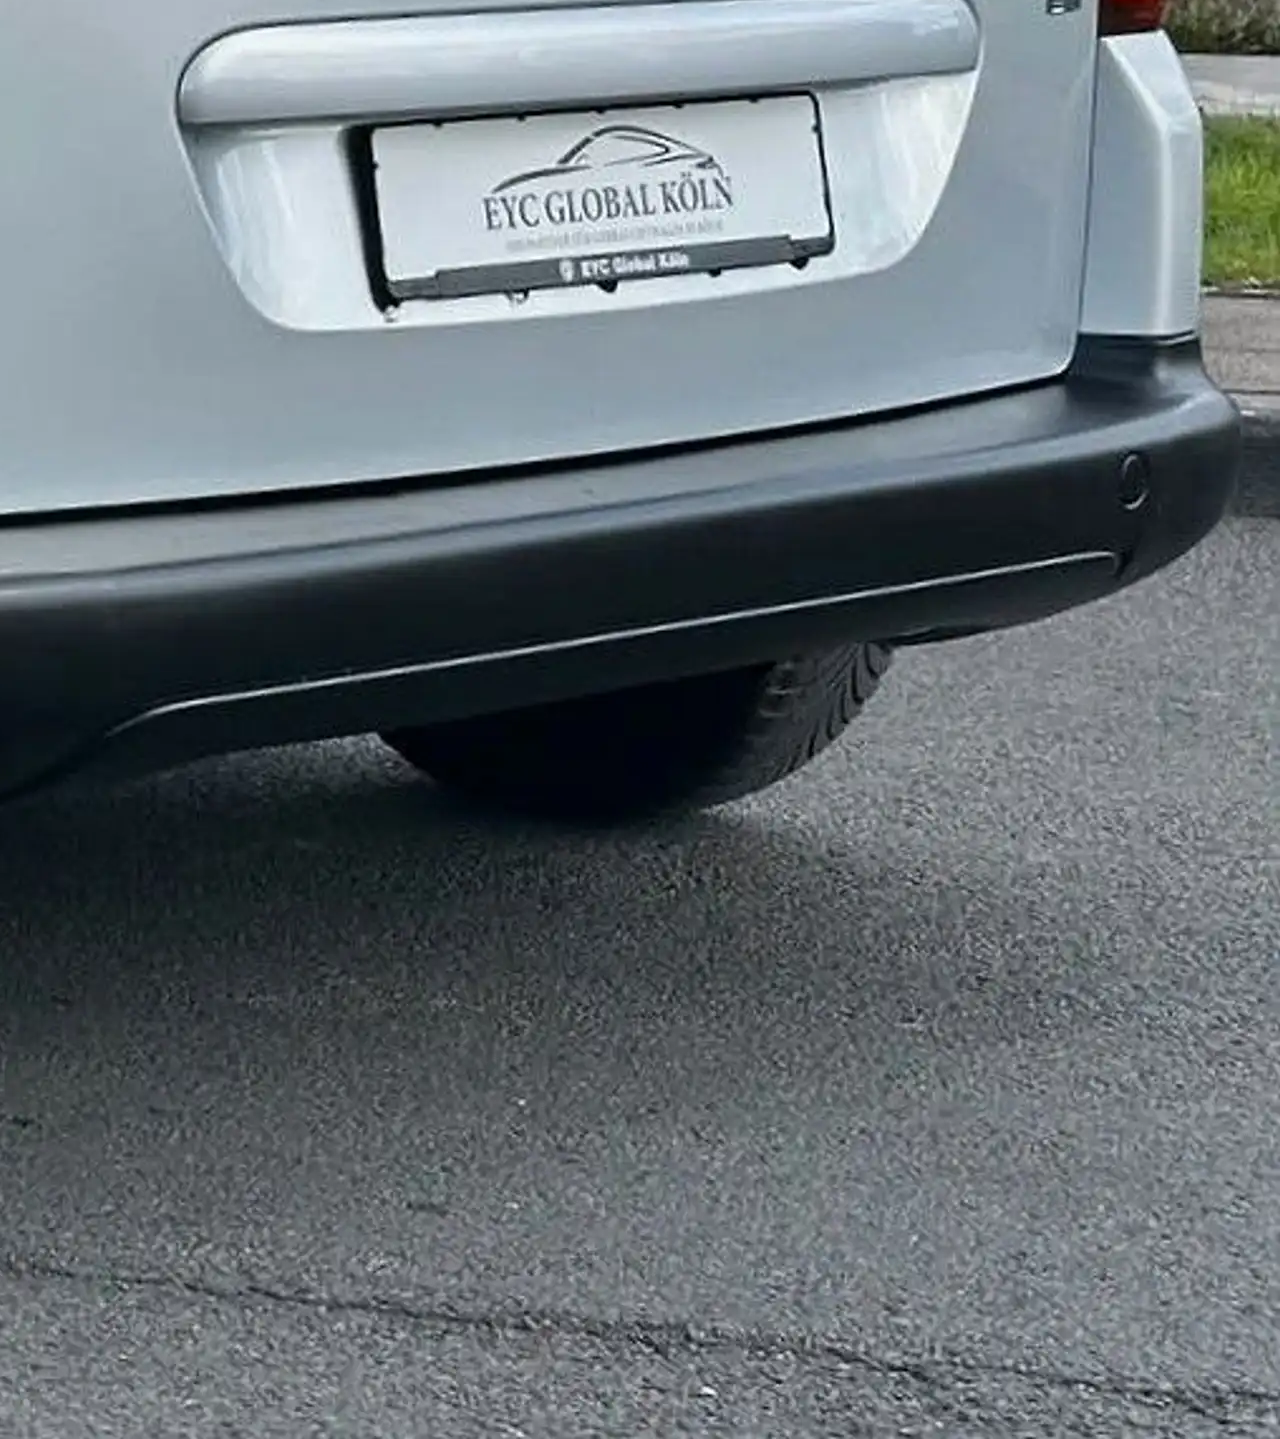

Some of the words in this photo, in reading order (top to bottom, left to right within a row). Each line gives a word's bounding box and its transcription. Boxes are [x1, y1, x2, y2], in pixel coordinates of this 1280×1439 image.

[483, 192, 541, 231] EYC
[544, 183, 657, 225] GLOBAL
[659, 171, 734, 213] KÖLN
[581, 258, 611, 278] EYC
